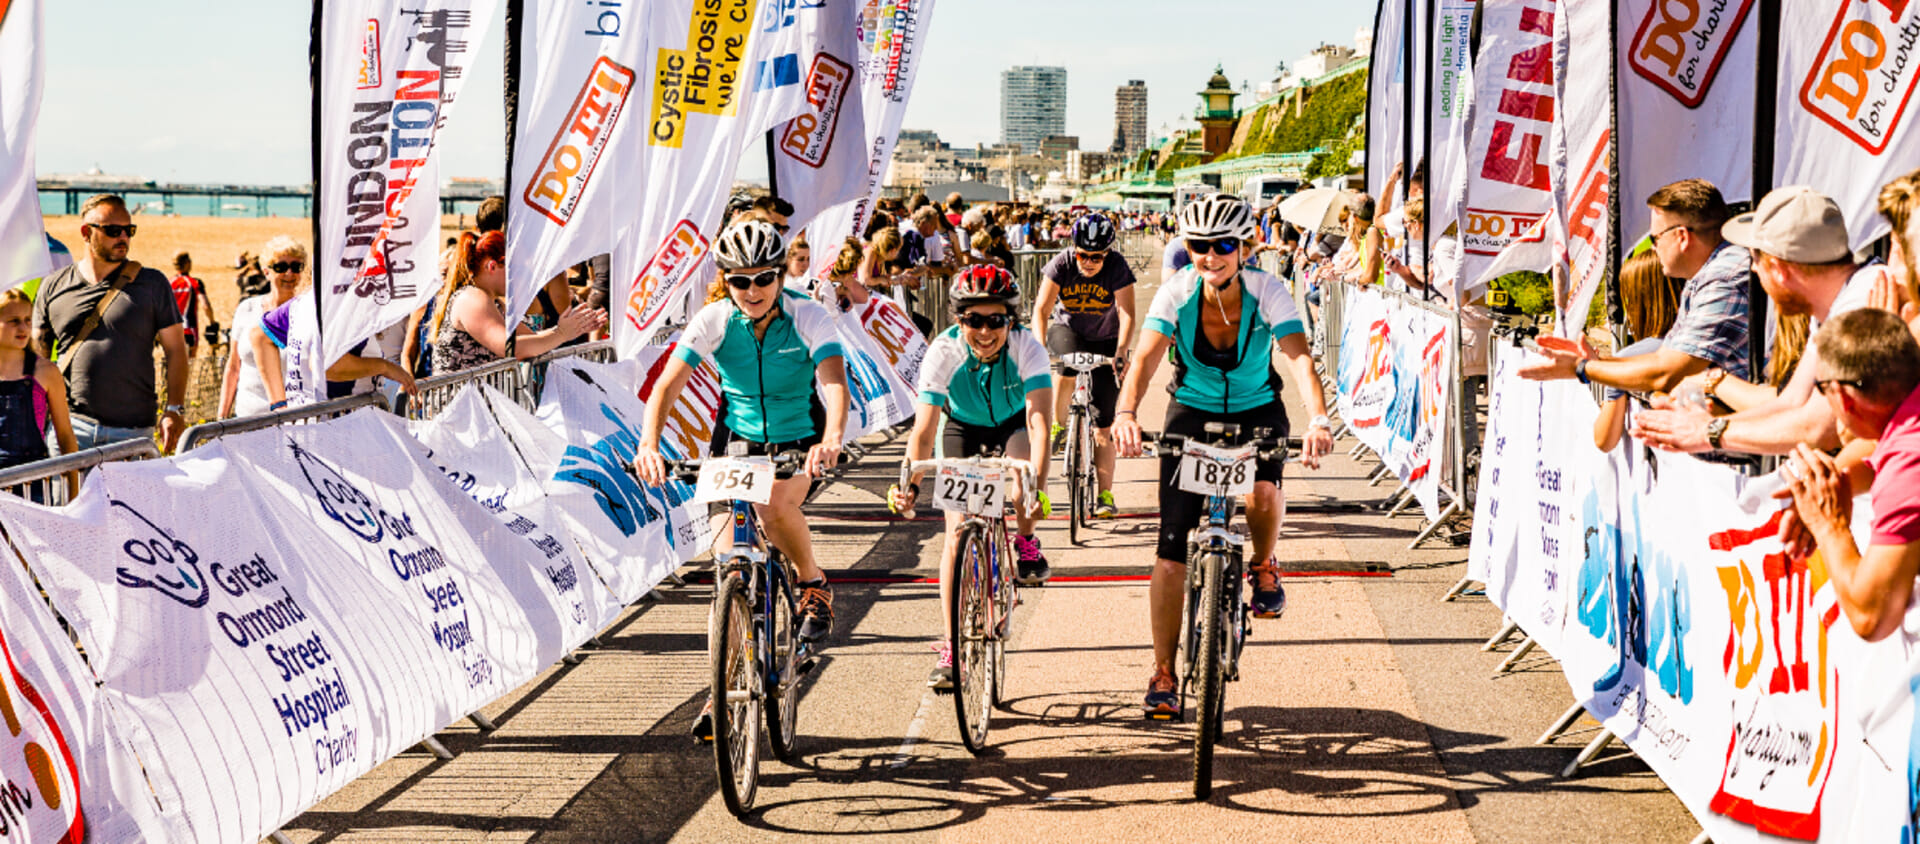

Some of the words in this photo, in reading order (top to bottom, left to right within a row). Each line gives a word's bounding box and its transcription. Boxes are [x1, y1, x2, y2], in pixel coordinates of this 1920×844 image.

[683, 0, 724, 105] Fibrosis
[1441, 14, 1455, 43] fight
[1442, 46, 1453, 67] the
[1455, 15, 1470, 71] dementia
[1640, 0, 1699, 77] DO
[653, 54, 685, 141] Cystic
[716, 34, 743, 108] we're
[1440, 70, 1454, 118] Leading
[1678, 56, 1699, 90] for
[1815, 19, 1887, 120] DO
[786, 113, 818, 155] DO
[808, 61, 844, 112] IT!
[1858, 98, 1887, 137] for
[533, 144, 582, 210] DO
[569, 70, 628, 146] IT!
[333, 100, 394, 294] NDON
[1465, 213, 1506, 237] DO
[628, 274, 658, 318] DO
[654, 229, 702, 277] IT!
[713, 469, 754, 490] 954
[943, 478, 995, 506] 2212
[1194, 460, 1246, 485] 1828
[209, 552, 279, 598] Great
[216, 585, 307, 648] Ormond
[265, 630, 332, 683] Street
[272, 667, 351, 738] Hospital
